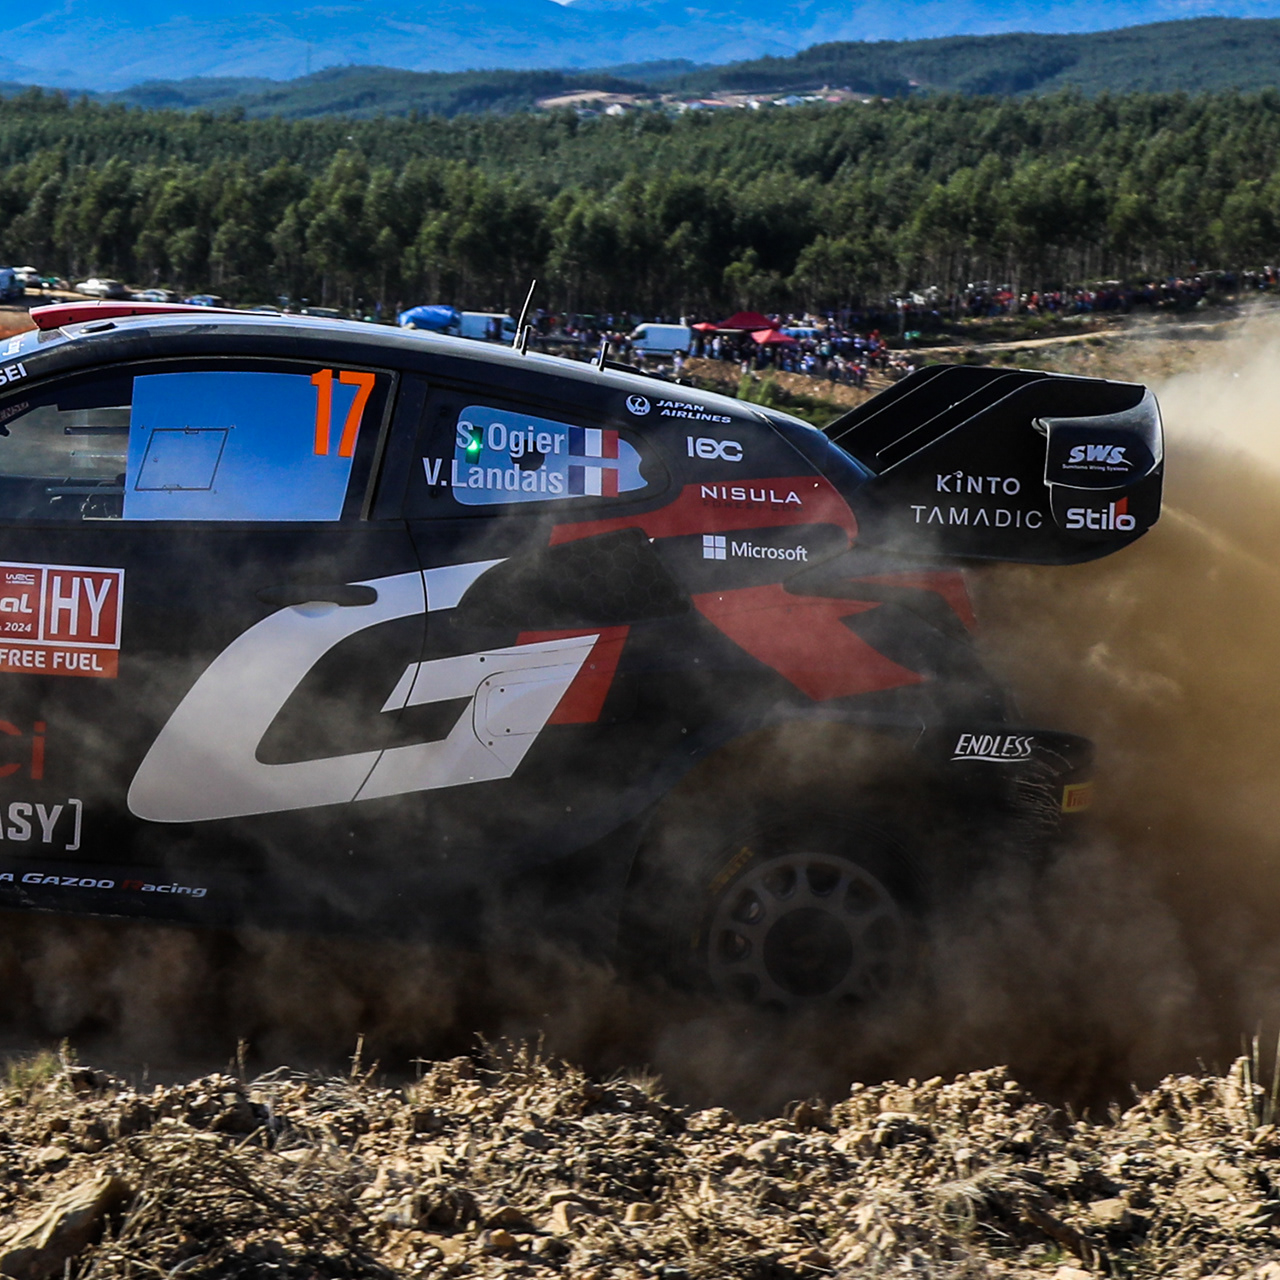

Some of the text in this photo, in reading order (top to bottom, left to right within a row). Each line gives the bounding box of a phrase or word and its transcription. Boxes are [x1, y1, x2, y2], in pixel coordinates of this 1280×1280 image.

[311, 369, 375, 457] 17
[656, 399, 705, 412] JAPAN
[660, 408, 732, 424] AIRLINES
[1068, 444, 1127, 464] SWS
[701, 485, 802, 505] NISULA
[910, 505, 1042, 529] TAMADIC
[1066, 501, 1136, 531] Stilo
[731, 541, 808, 562] Microsoft
[50, 575, 112, 637] HY
[4, 622, 32, 632] 2024
[53, 652, 103, 672] FUEL
[954, 733, 1034, 757] ENDLESS
[21, 872, 115, 889] GAZOO
[121, 879, 208, 898] Racing
